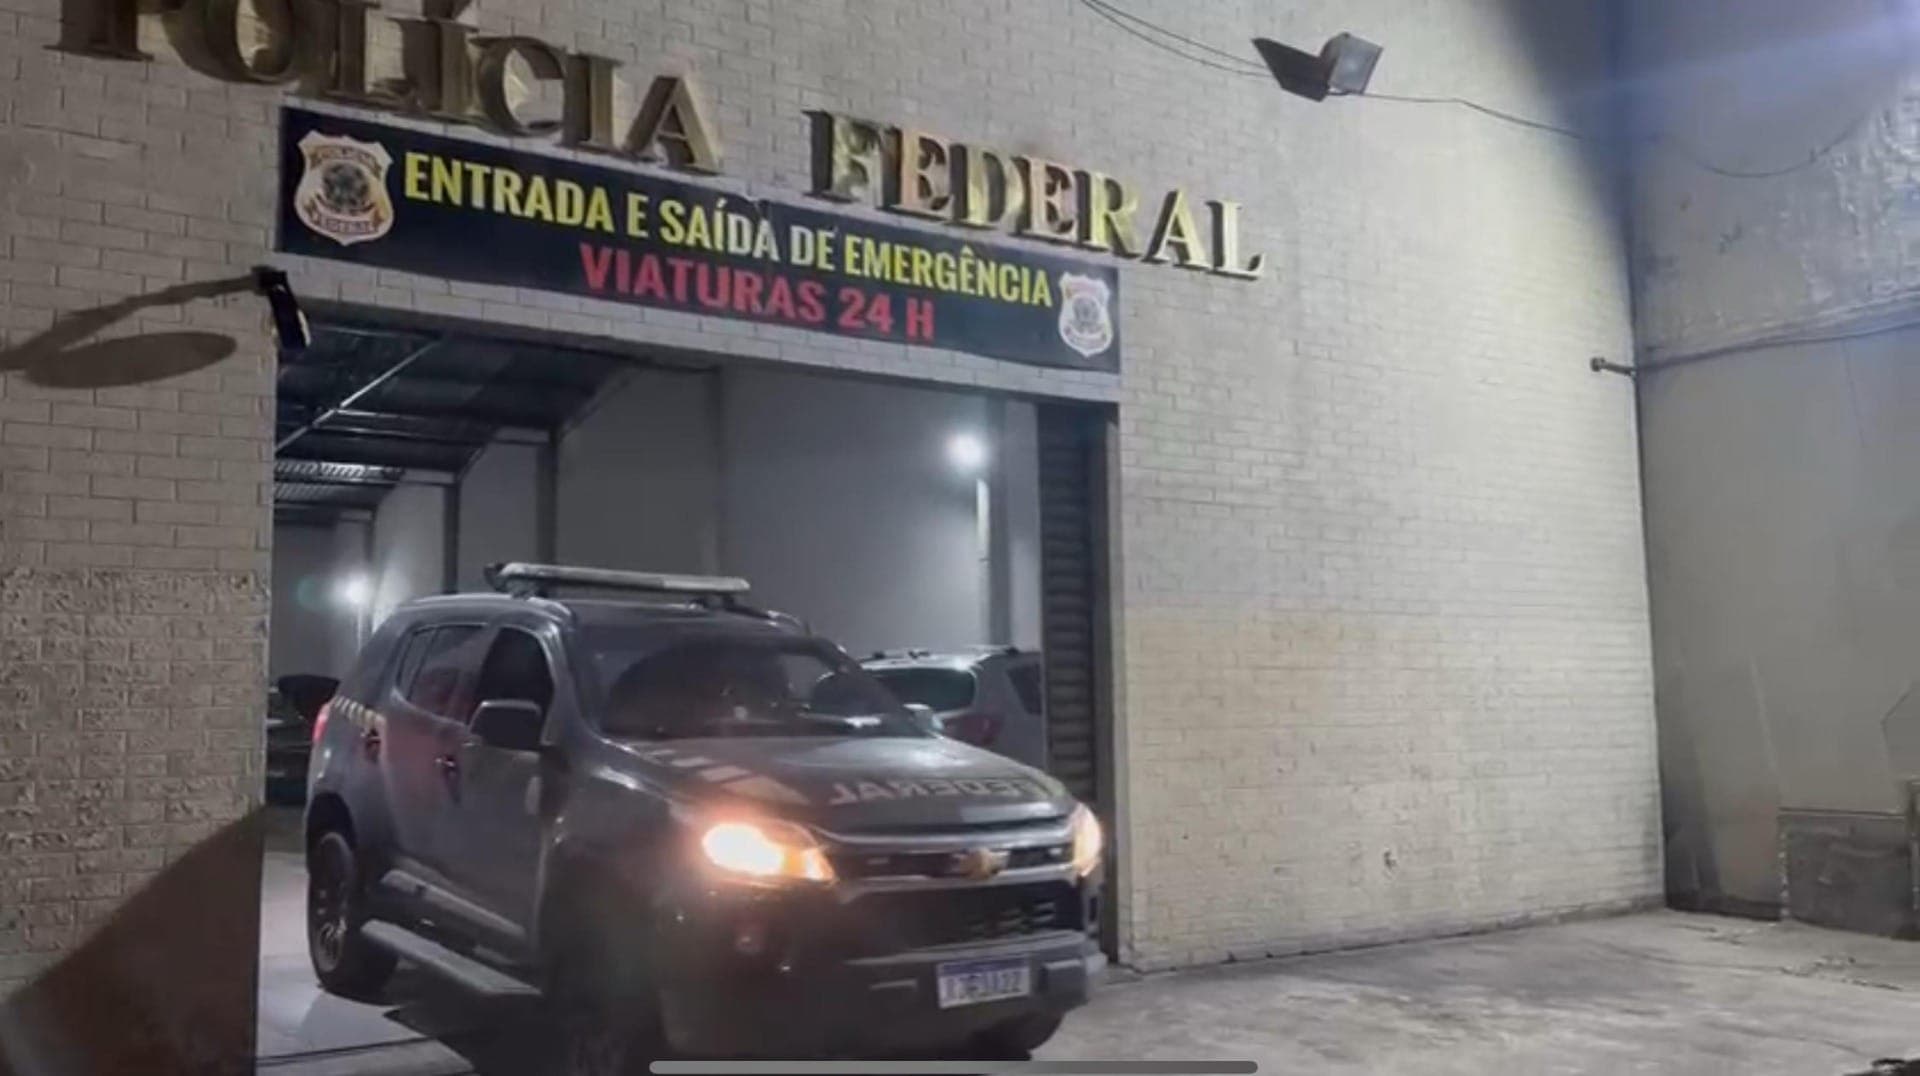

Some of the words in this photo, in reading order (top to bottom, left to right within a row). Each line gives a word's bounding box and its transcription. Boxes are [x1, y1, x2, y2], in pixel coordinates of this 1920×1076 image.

[405, 152, 616, 234] ENTRADA
[626, 192, 649, 238] E
[659, 198, 780, 263] SAÍDA
[789, 224, 836, 271] DE
[844, 234, 1053, 307] EMERGÊNCIA
[802, 108, 1266, 280] FEDERAL
[579, 243, 827, 323] VIATURAS
[838, 286, 895, 335] 24
[905, 297, 935, 341] H
